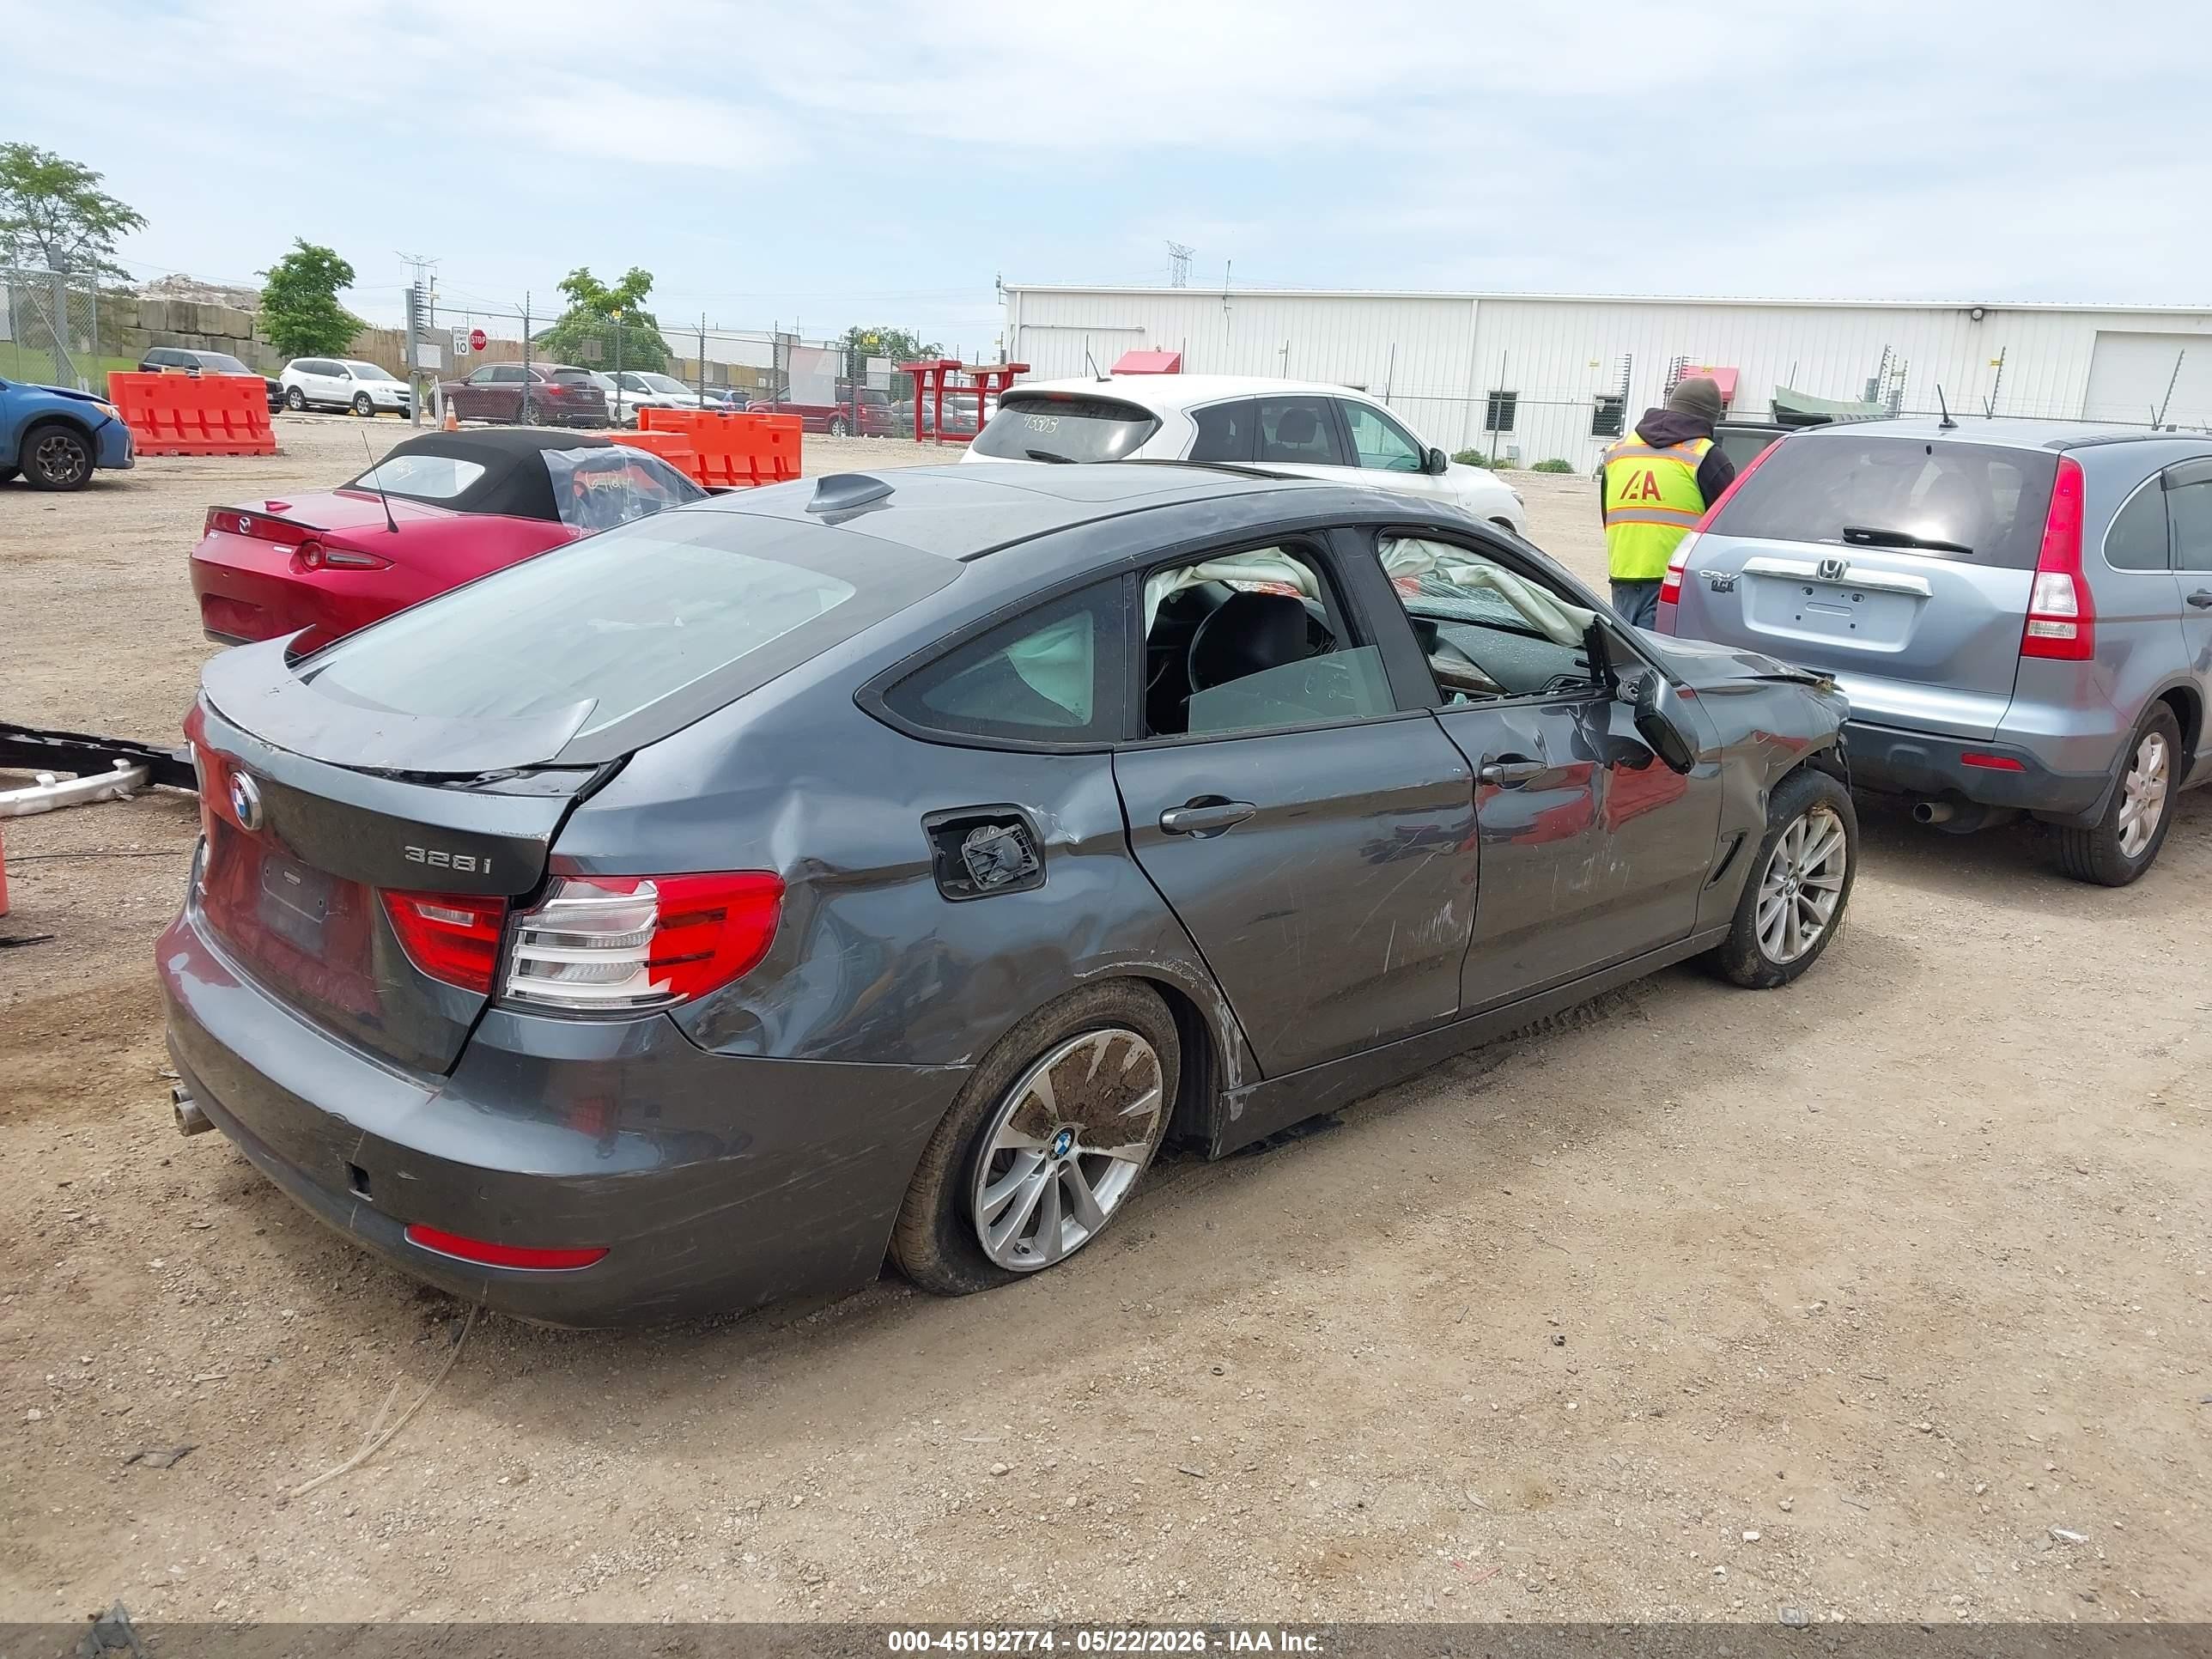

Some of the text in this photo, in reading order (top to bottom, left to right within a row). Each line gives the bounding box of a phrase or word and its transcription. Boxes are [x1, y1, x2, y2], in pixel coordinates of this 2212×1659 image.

[471, 335, 486, 344] STOP
[456, 343, 467, 353] 10
[404, 845, 492, 874] 328i
